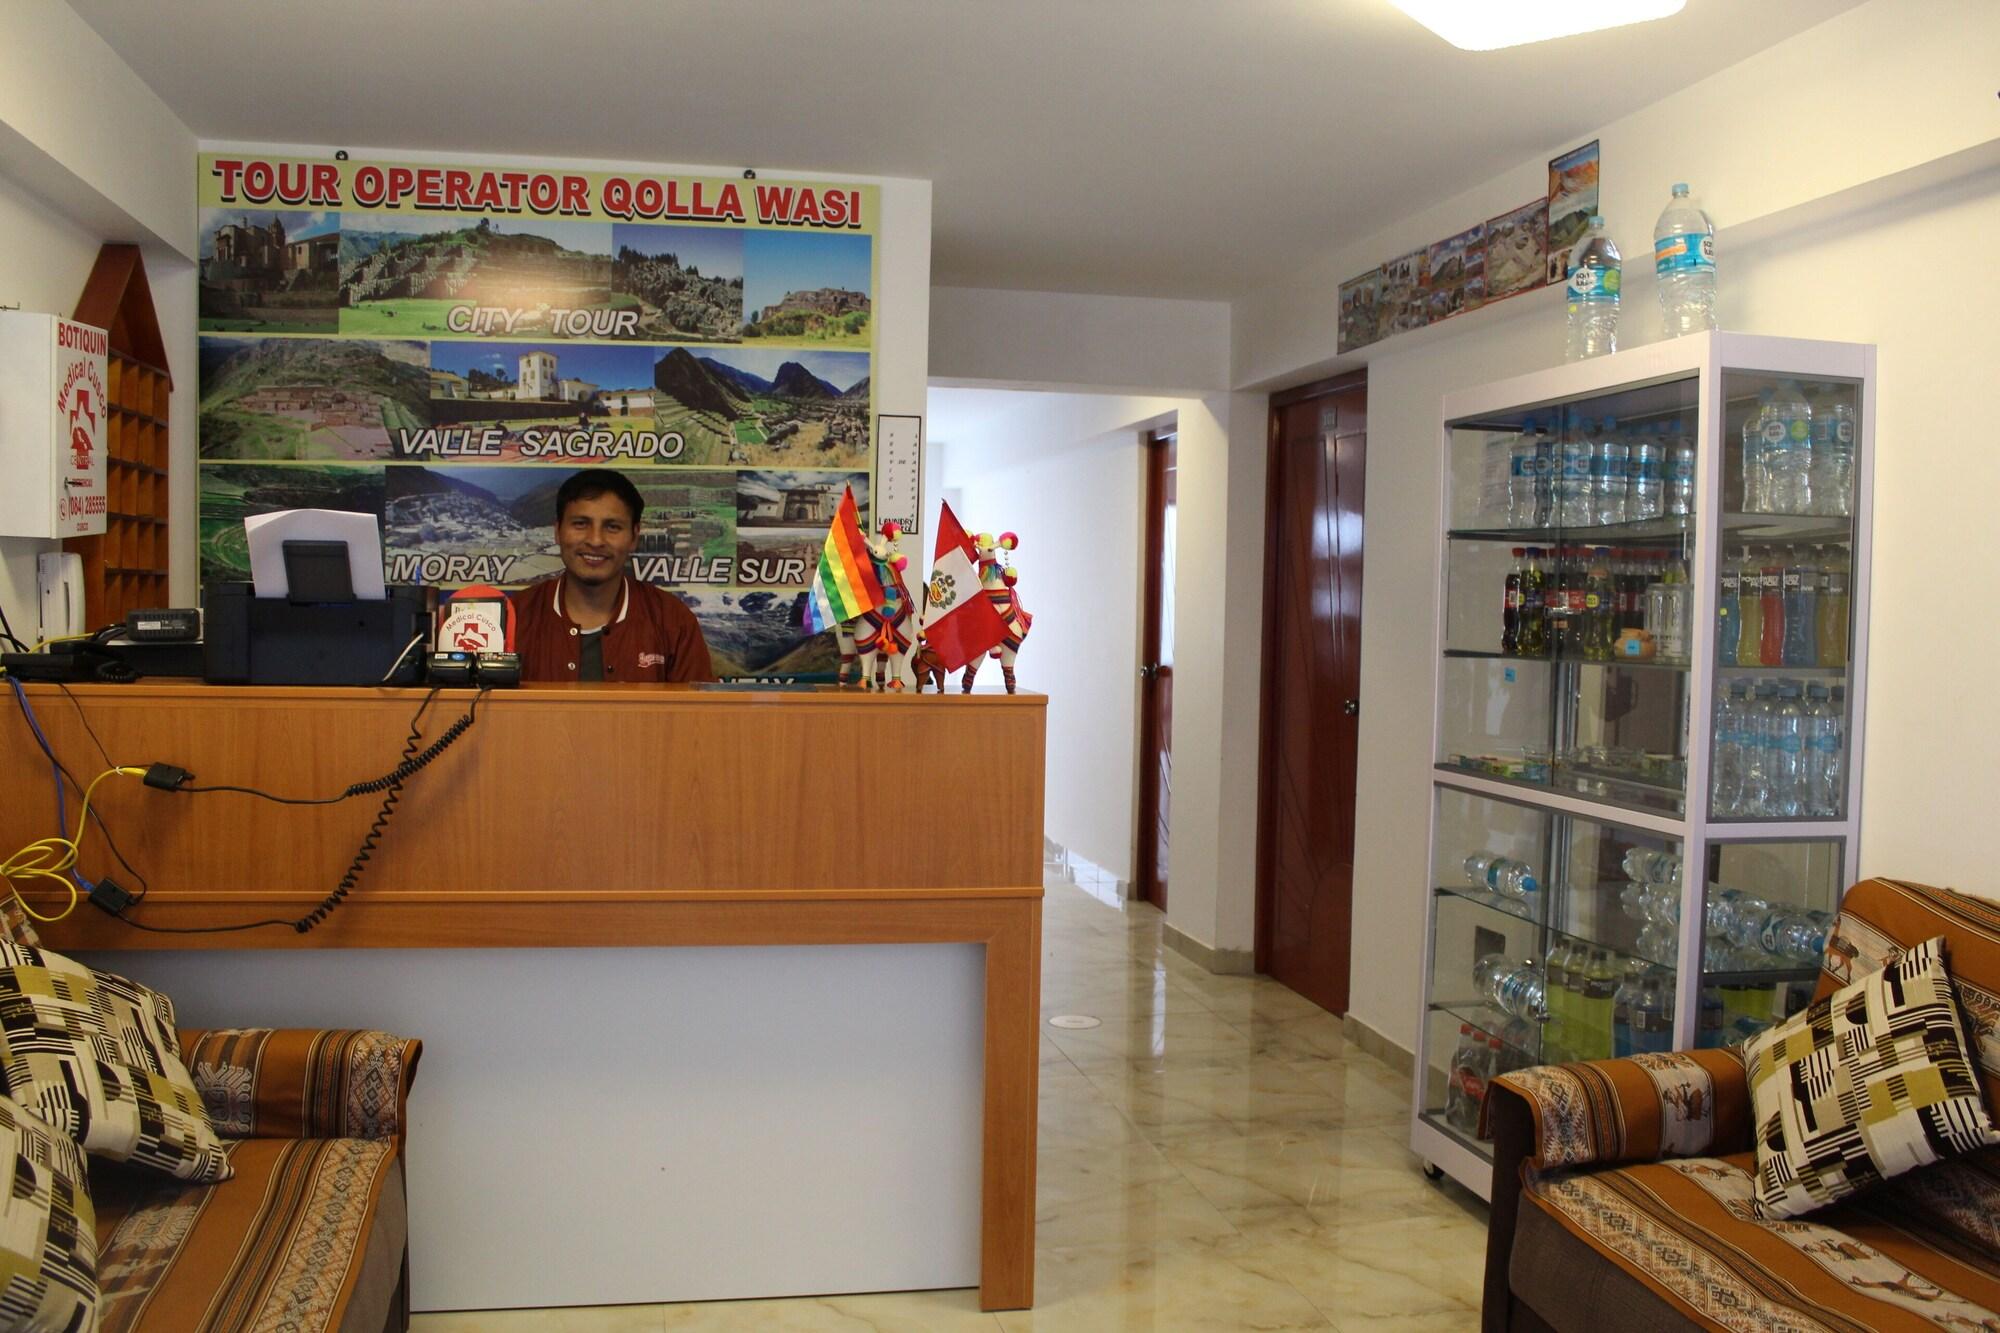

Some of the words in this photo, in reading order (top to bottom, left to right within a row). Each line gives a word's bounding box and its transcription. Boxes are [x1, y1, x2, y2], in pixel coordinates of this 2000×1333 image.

[213, 160, 342, 205] TOUR
[353, 166, 591, 215] OPERATOR
[602, 178, 746, 222] QOLLA
[755, 185, 861, 229] WASI
[448, 305, 524, 333] CITY
[549, 308, 639, 336] TOUR
[58, 321, 107, 357] BOTIQUIN
[57, 357, 86, 415] Medical
[88, 360, 107, 419] Cusco
[400, 429, 503, 456] VALLE
[520, 429, 685, 459] SAGRADO
[390, 554, 517, 582] MORAY
[631, 555, 734, 583] VALLE
[737, 557, 807, 584] SUR
[446, 614, 474, 631] Medical
[477, 614, 496, 631] Cusco
